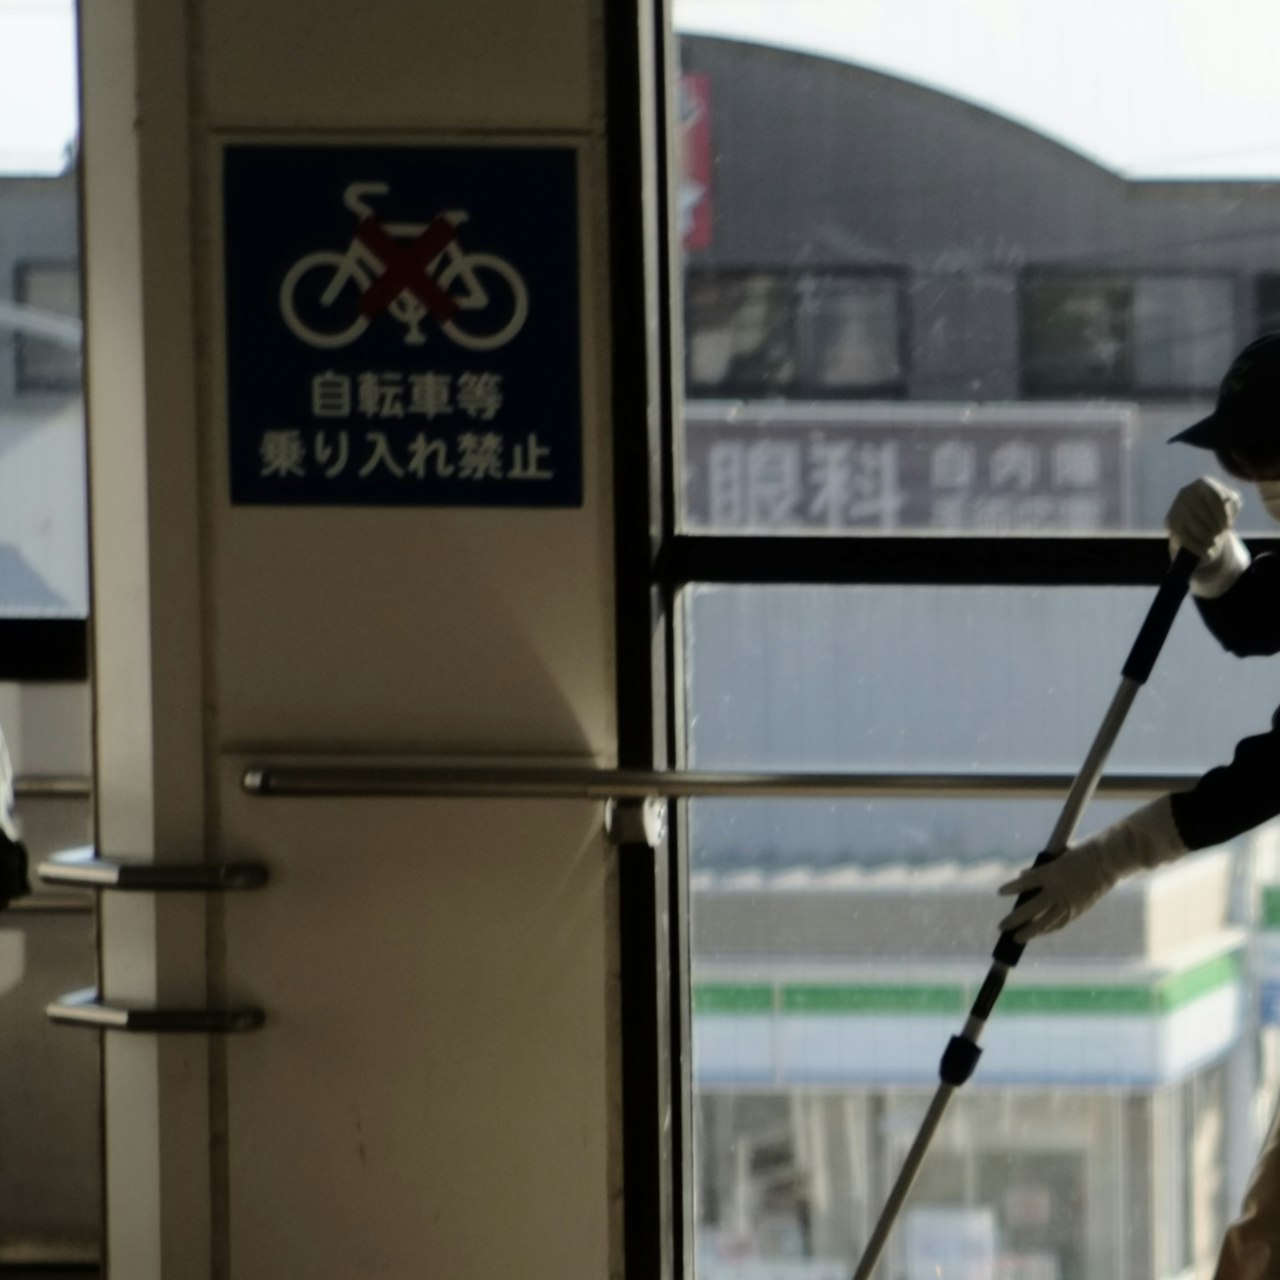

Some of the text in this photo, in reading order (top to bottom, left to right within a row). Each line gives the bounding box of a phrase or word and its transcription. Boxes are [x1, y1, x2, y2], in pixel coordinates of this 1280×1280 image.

[311, 371, 504, 420] 自転車等
[259, 431, 555, 483] 乗り入れ禁止
[708, 433, 906, 529] 眼科
